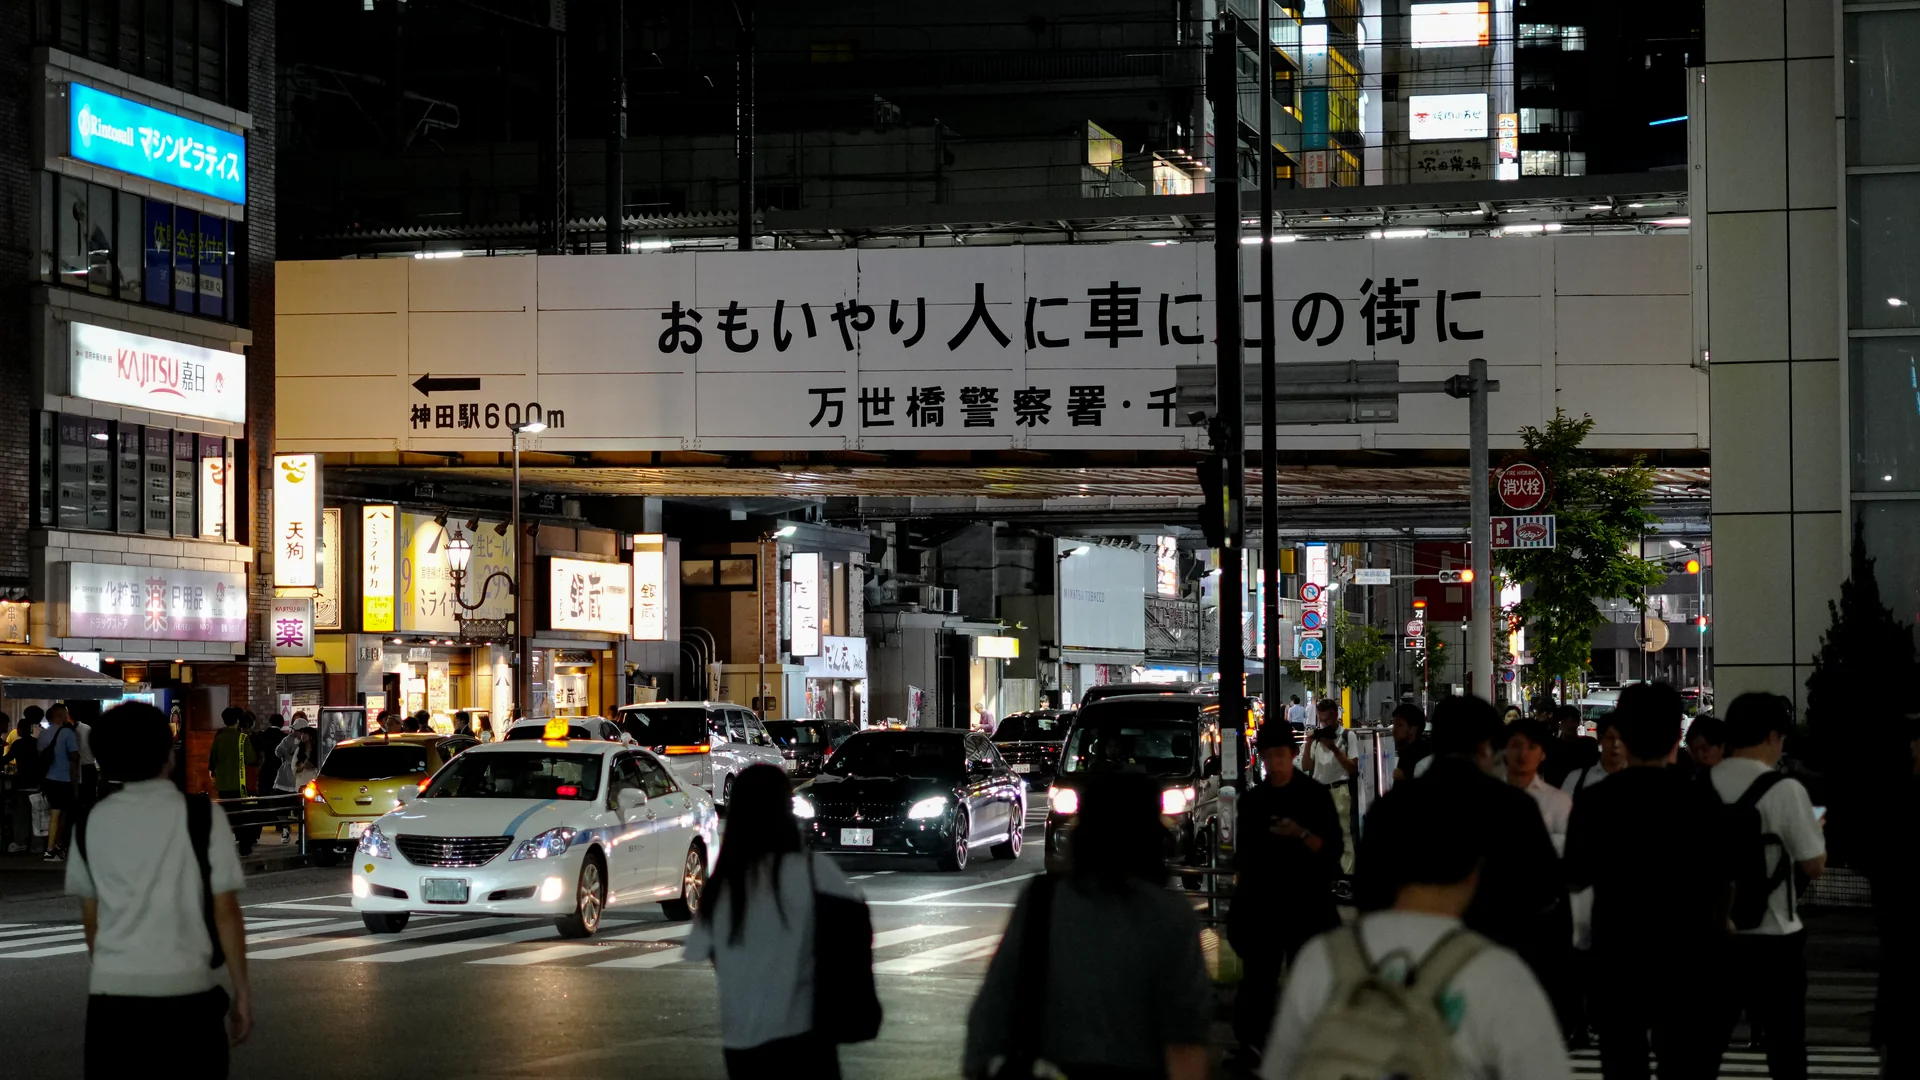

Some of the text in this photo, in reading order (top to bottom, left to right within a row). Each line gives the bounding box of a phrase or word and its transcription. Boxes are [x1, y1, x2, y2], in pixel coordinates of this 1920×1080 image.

[138, 127, 241, 183] マシンピラティス
[118, 348, 178, 388] KAJITSU
[181, 361, 205, 393] 嘉日
[410, 403, 566, 431] 神田駅600m
[1503, 478, 1541, 496] 消火栓
[285, 521, 305, 561] 天狗
[476, 534, 511, 558] 生ビール
[1495, 537, 1509, 545] 80m
[105, 581, 141, 608] 化粧品
[144, 576, 169, 633] 薬
[172, 585, 204, 611] 日用品
[275, 605, 296, 613] KAJITSU
[90, 618, 129, 630] ドラッグストア
[276, 618, 304, 648] 薬
